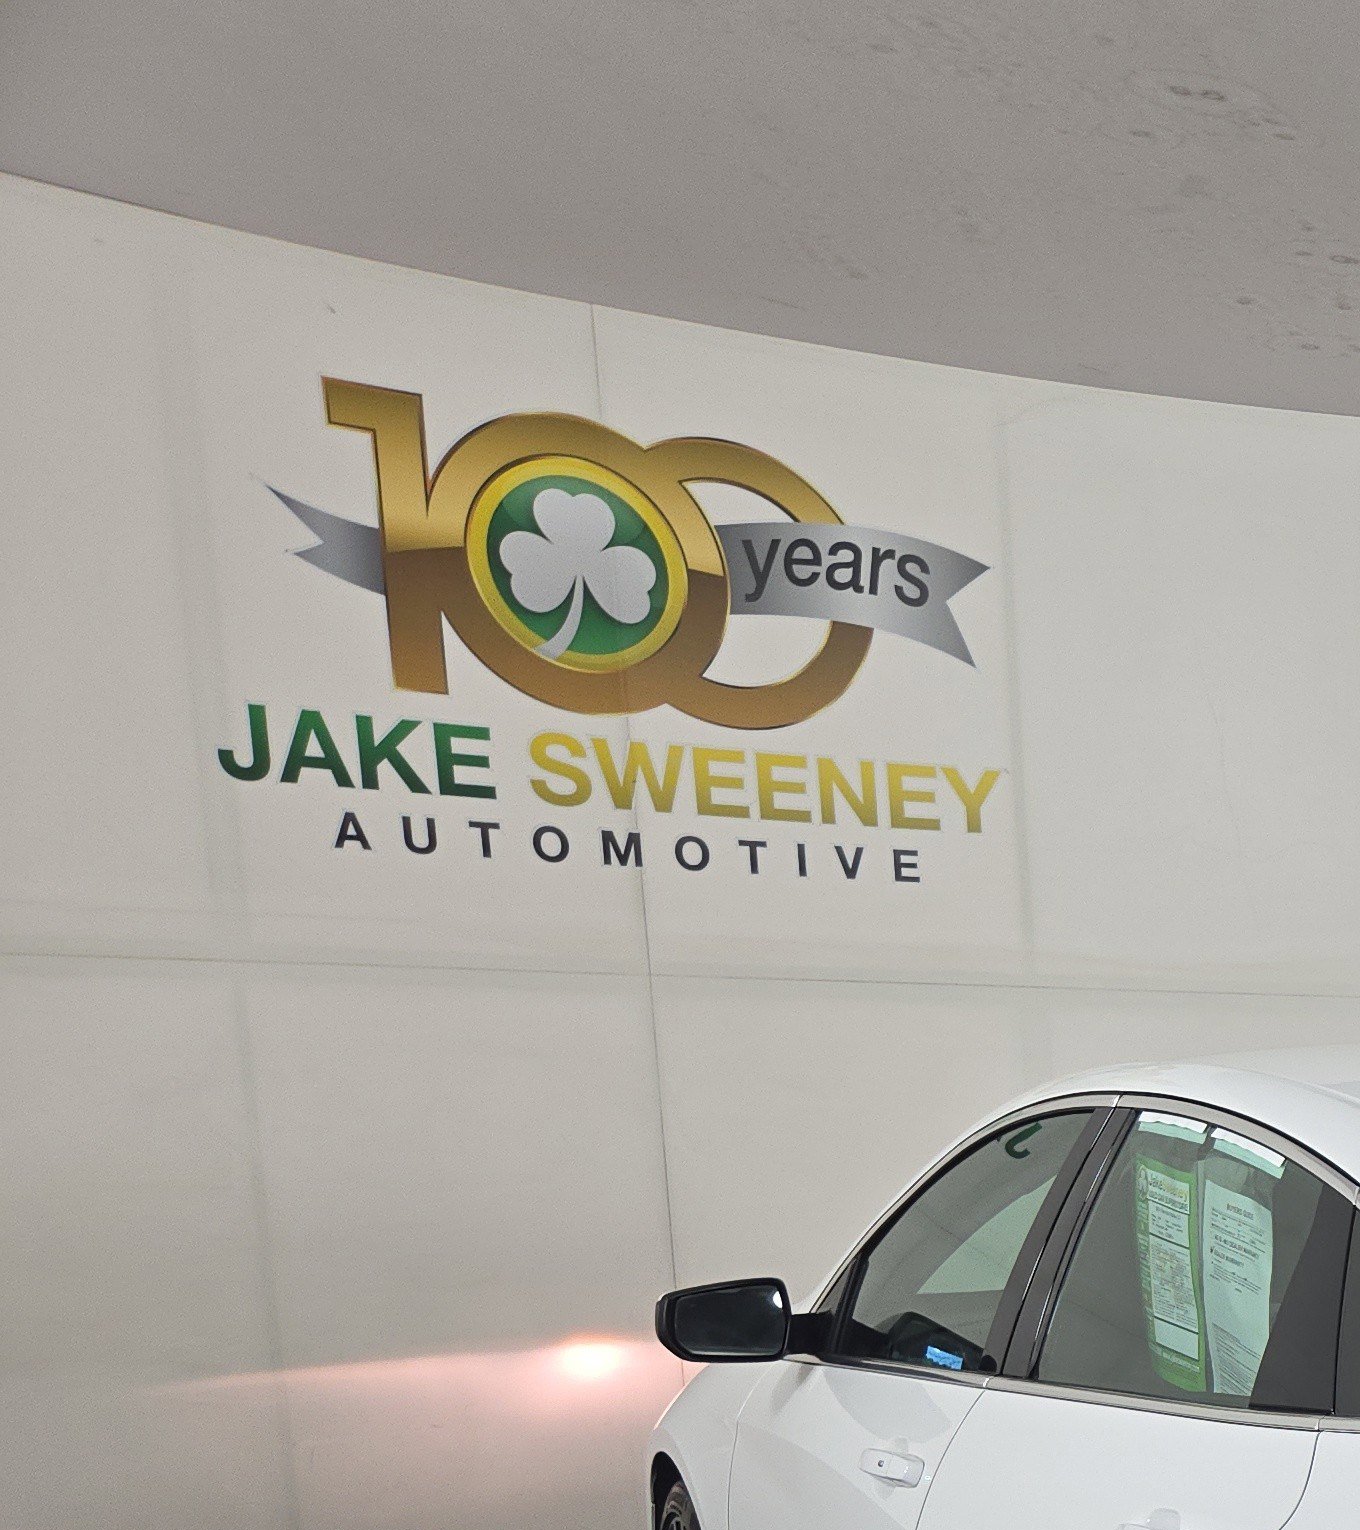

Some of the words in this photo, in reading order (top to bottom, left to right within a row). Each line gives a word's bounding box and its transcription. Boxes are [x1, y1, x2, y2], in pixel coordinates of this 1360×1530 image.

[321, 375, 875, 731] 100
[741, 534, 931, 608] years
[217, 703, 498, 801] JAKE
[529, 732, 1001, 835] SWEENEY
[334, 809, 924, 884] AUTOMOTIVE
